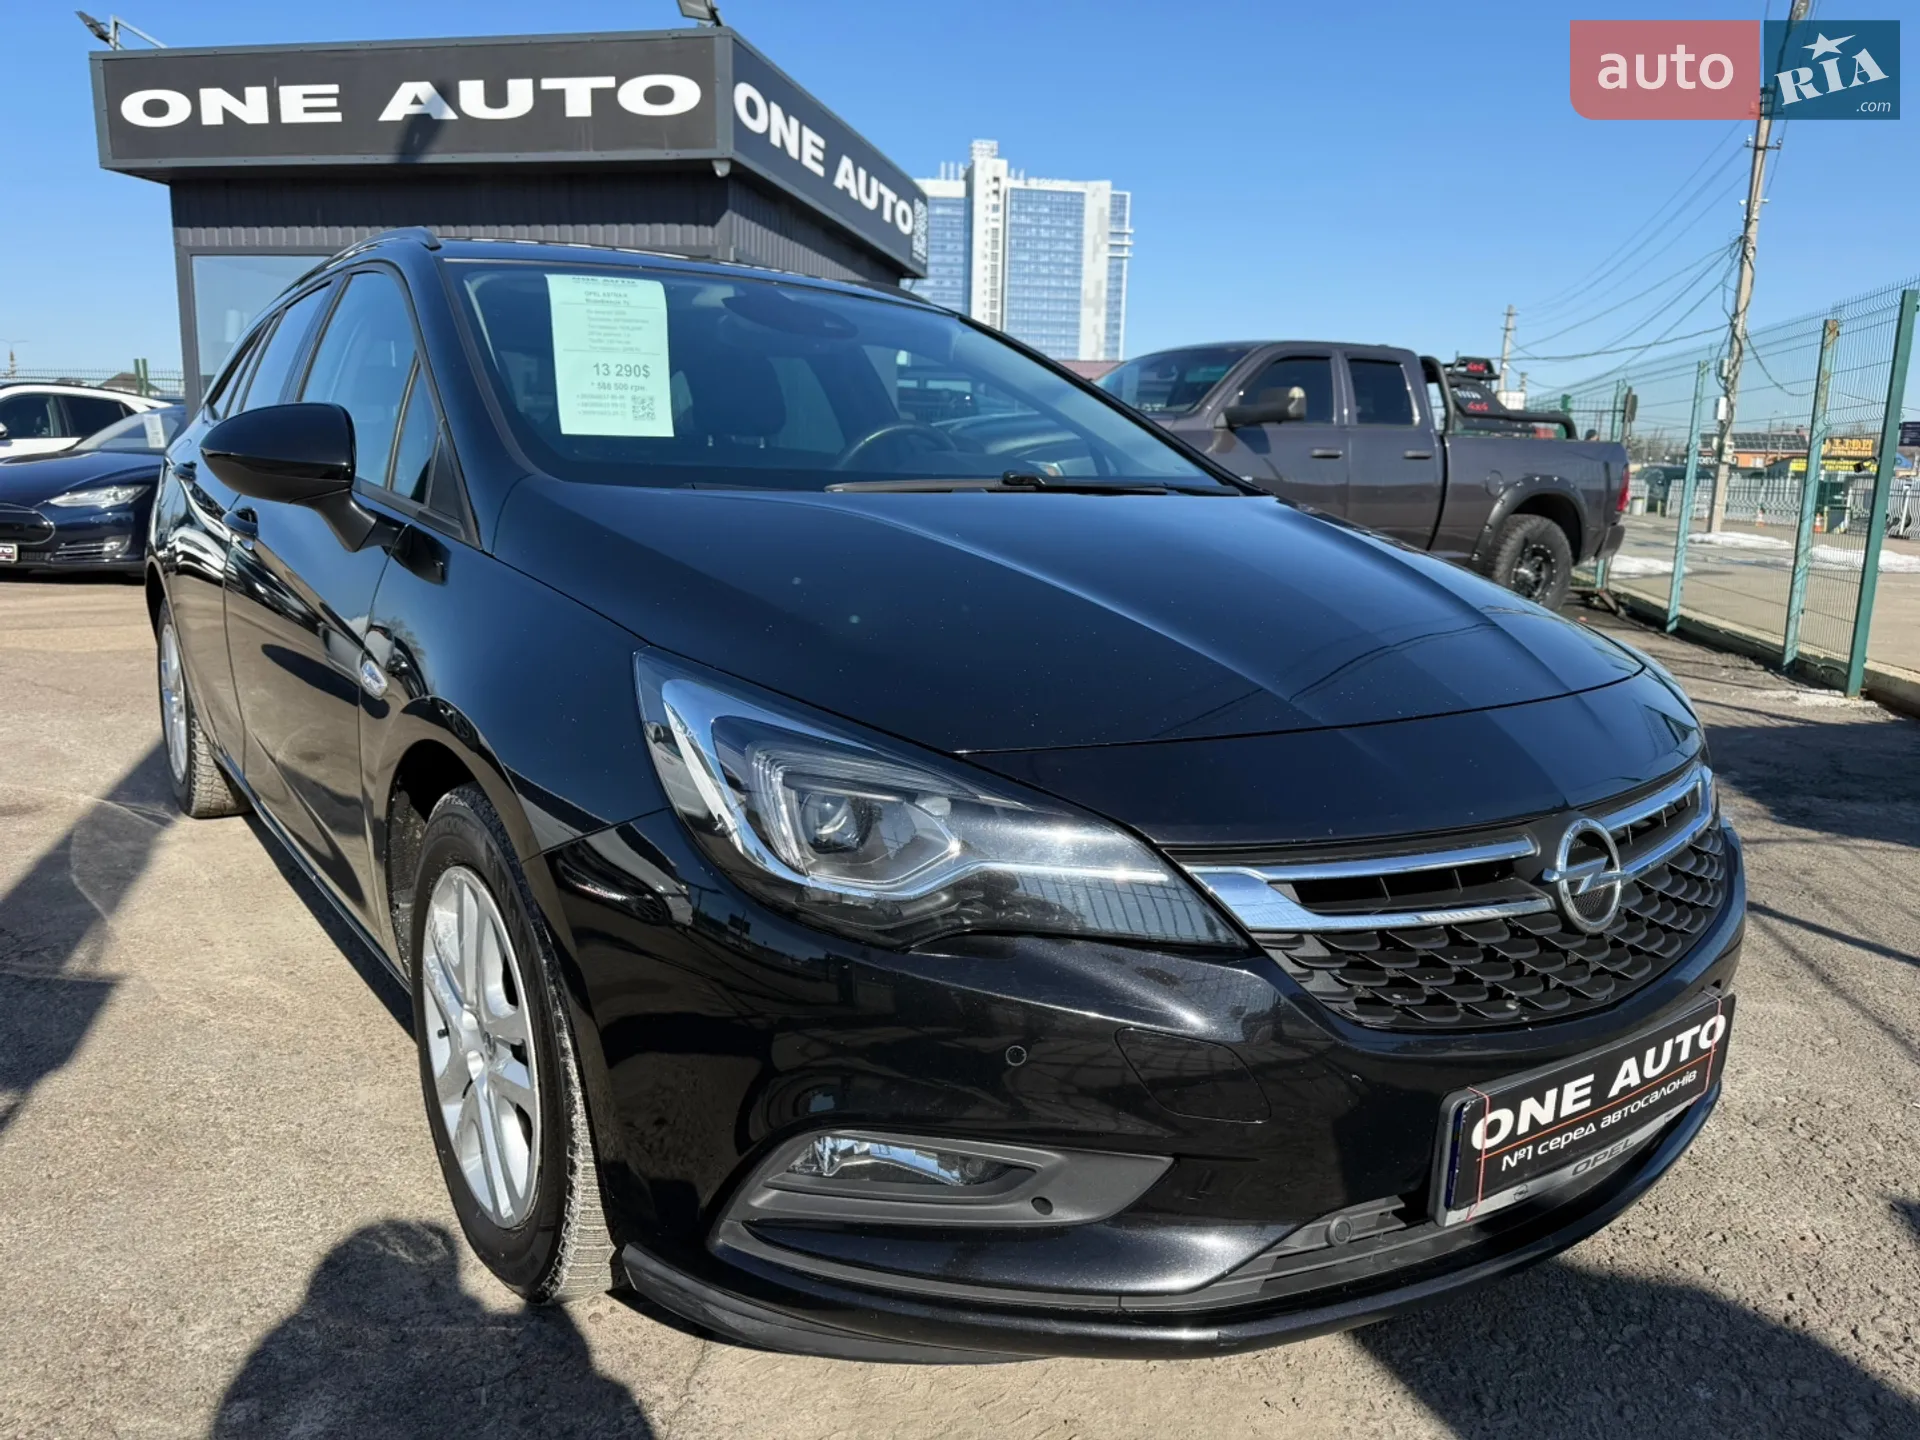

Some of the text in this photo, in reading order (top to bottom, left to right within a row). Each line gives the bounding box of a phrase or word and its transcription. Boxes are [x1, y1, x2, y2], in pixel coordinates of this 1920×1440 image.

[120, 74, 701, 128] ONE AUTO
[733, 82, 914, 235] ONE AUTO
[593, 362, 651, 379] 13 290$
[1471, 1014, 1727, 1151] ONE AUTO
[1537, 1121, 1597, 1156] серед
[1600, 1069, 1698, 1130] автосалонів
[1571, 1136, 1635, 1176] OPEL
